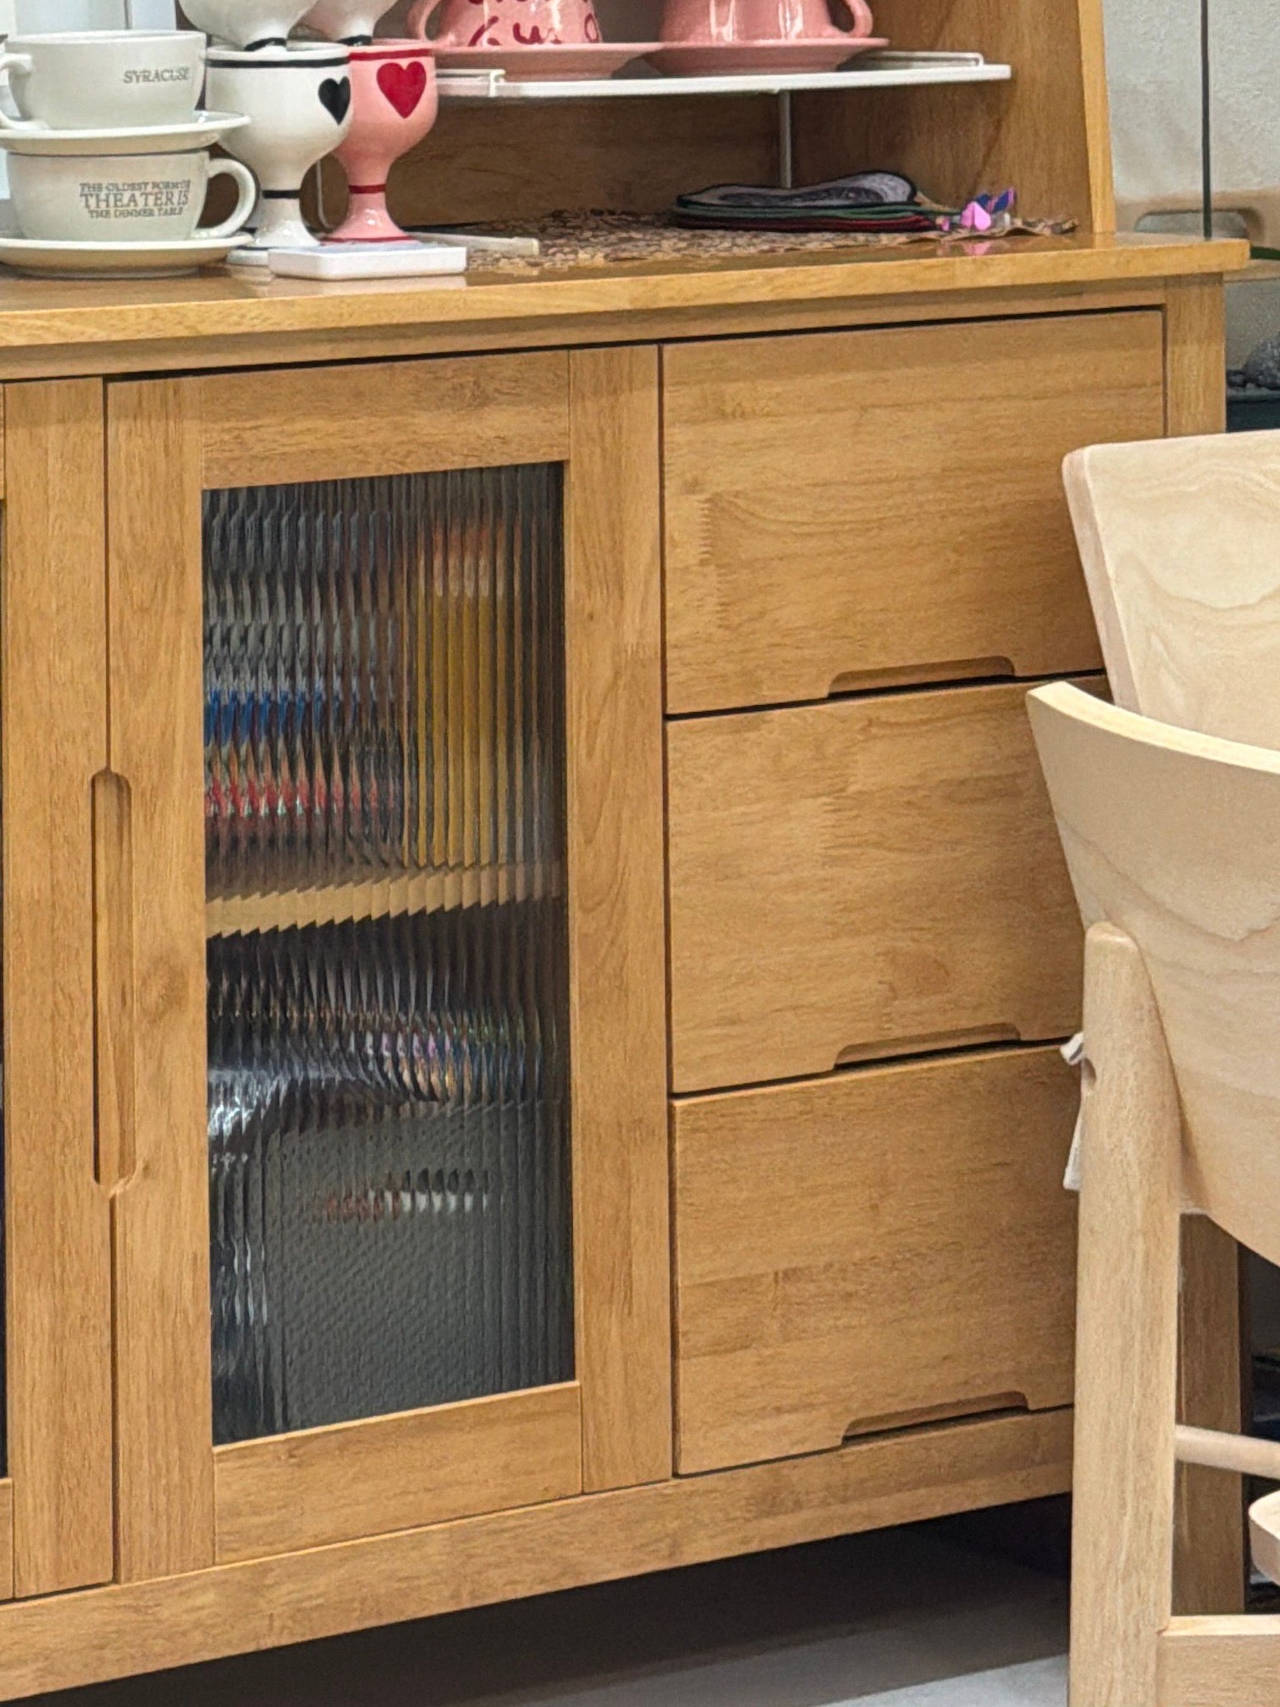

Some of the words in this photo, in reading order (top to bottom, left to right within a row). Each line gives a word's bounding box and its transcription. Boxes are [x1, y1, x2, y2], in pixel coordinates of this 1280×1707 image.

[123, 66, 190, 84] SYRACUSE
[79, 183, 103, 193] THE
[105, 182, 149, 192] OLDEST
[80, 191, 174, 209] THEATER
[177, 190, 189, 206] IS
[88, 209, 111, 219] THE
[114, 208, 155, 219] DINNER
